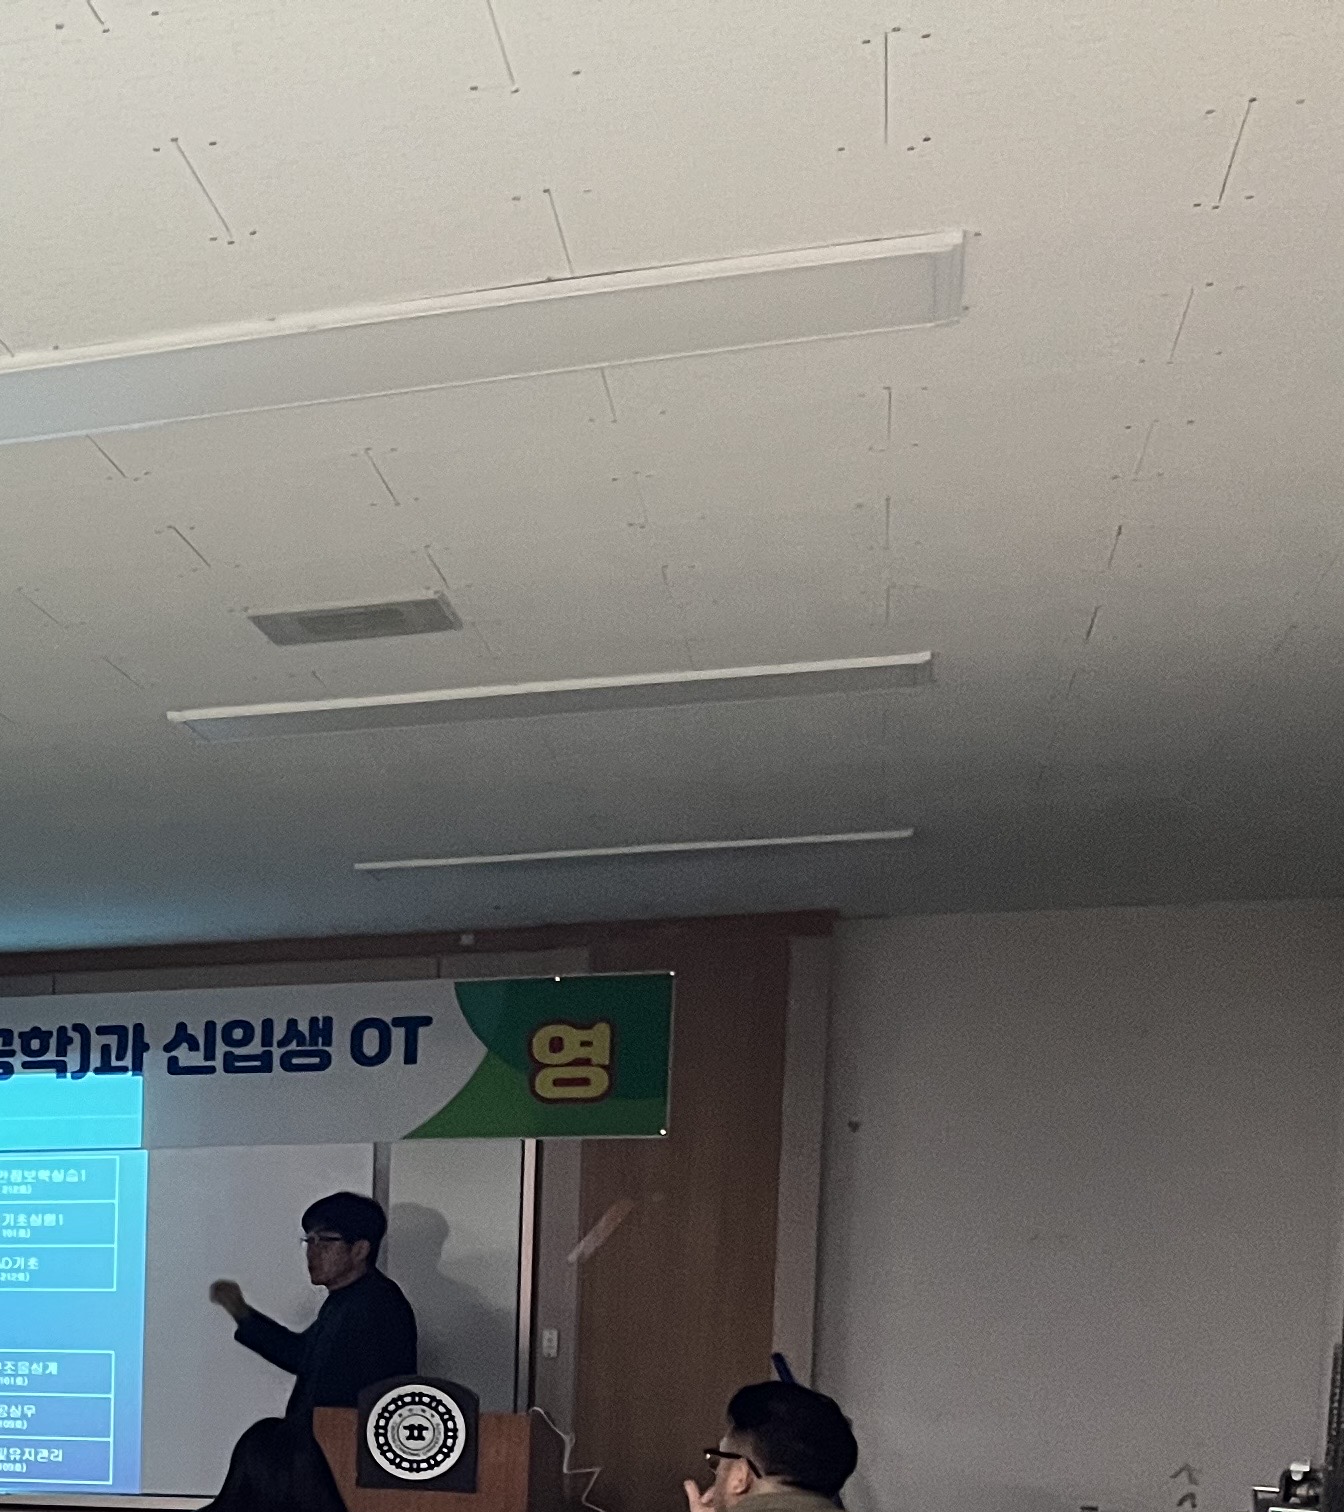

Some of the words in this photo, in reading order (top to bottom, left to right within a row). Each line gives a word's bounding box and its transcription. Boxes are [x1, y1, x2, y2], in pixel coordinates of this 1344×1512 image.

[162, 1015, 334, 1076] 신입생
[350, 1015, 434, 1067] OT
[529, 1020, 614, 1102] 영
